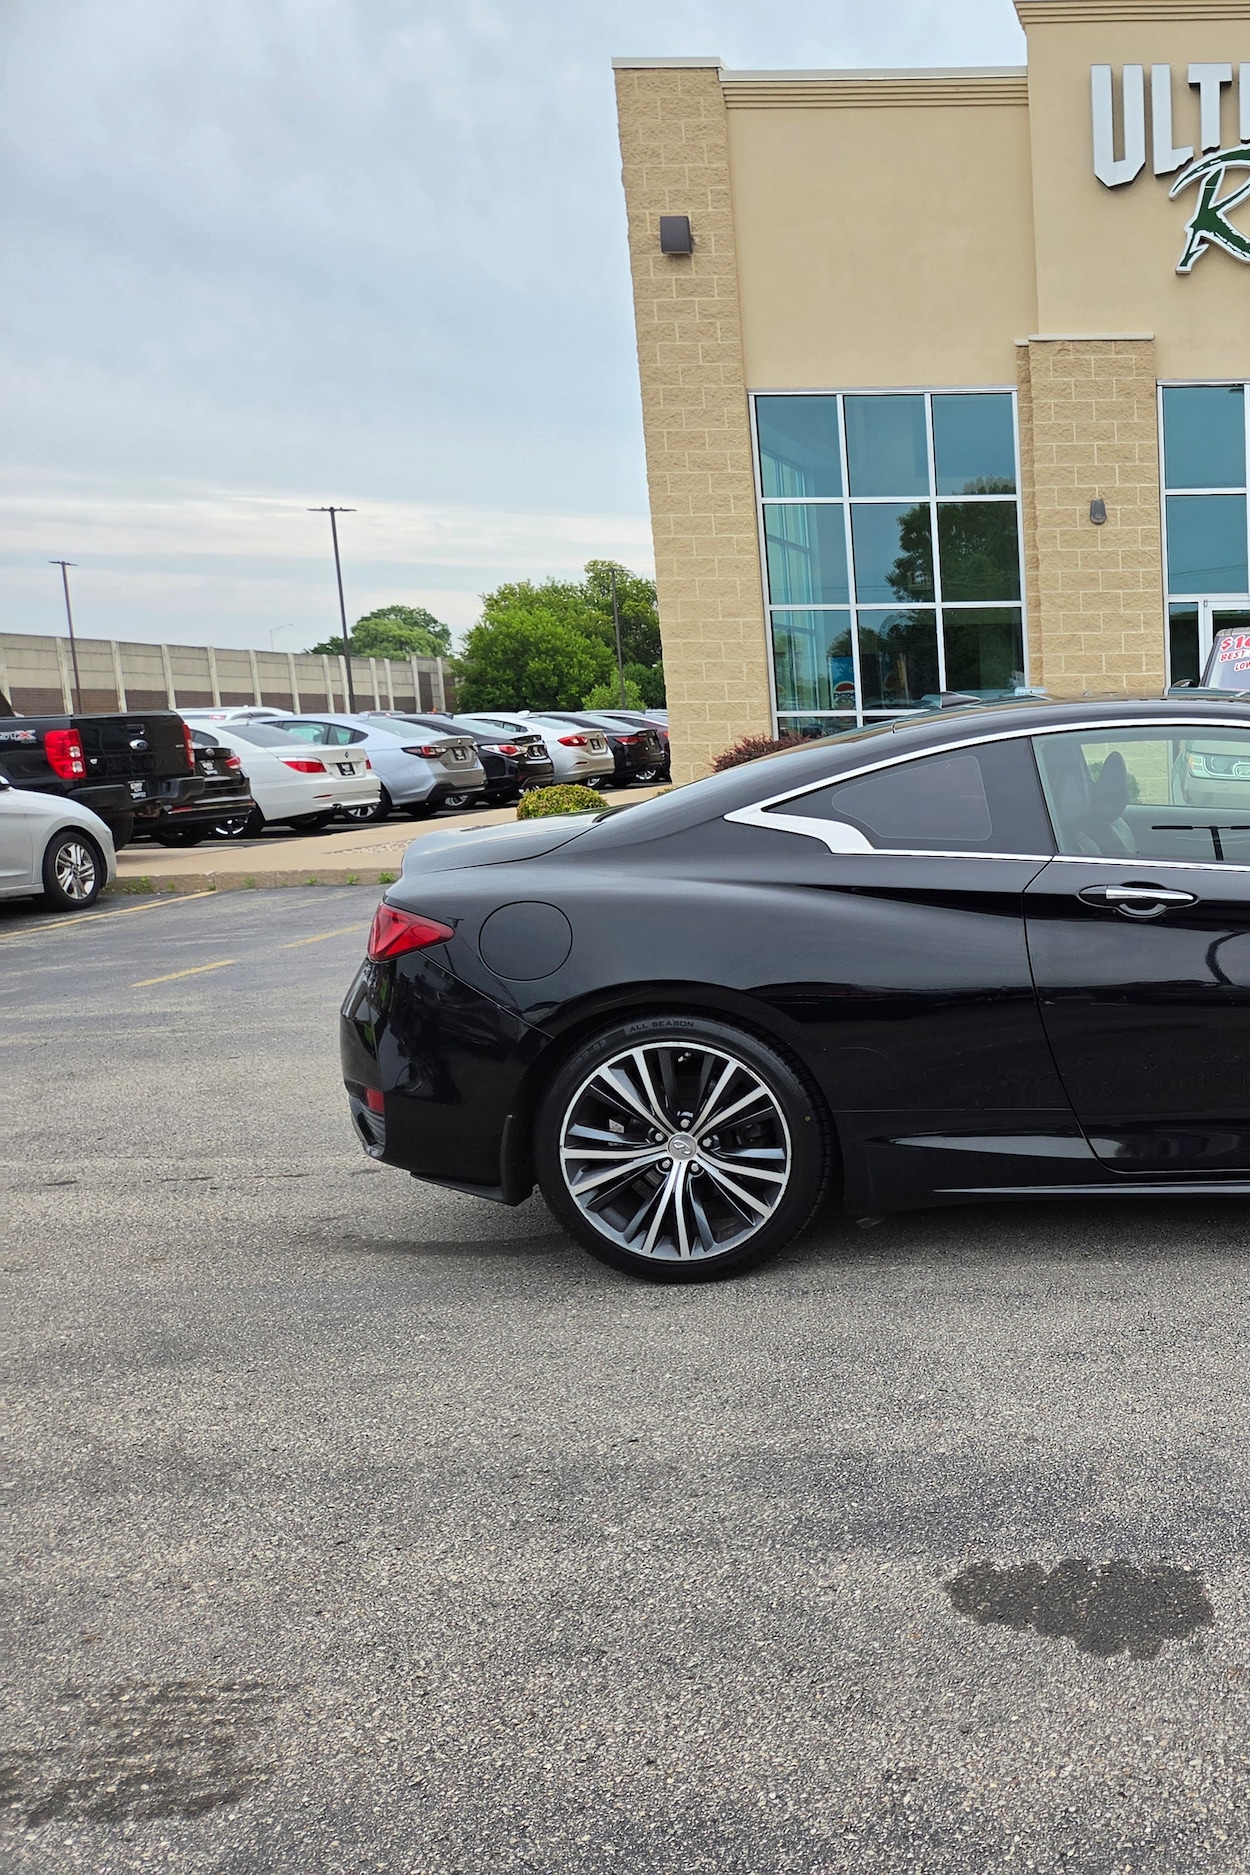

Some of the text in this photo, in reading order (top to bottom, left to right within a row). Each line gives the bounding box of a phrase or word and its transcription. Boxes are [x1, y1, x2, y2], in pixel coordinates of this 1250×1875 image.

[1219, 650, 1247, 662] BEST
[629, 1020, 695, 1033] ALL SEASON
